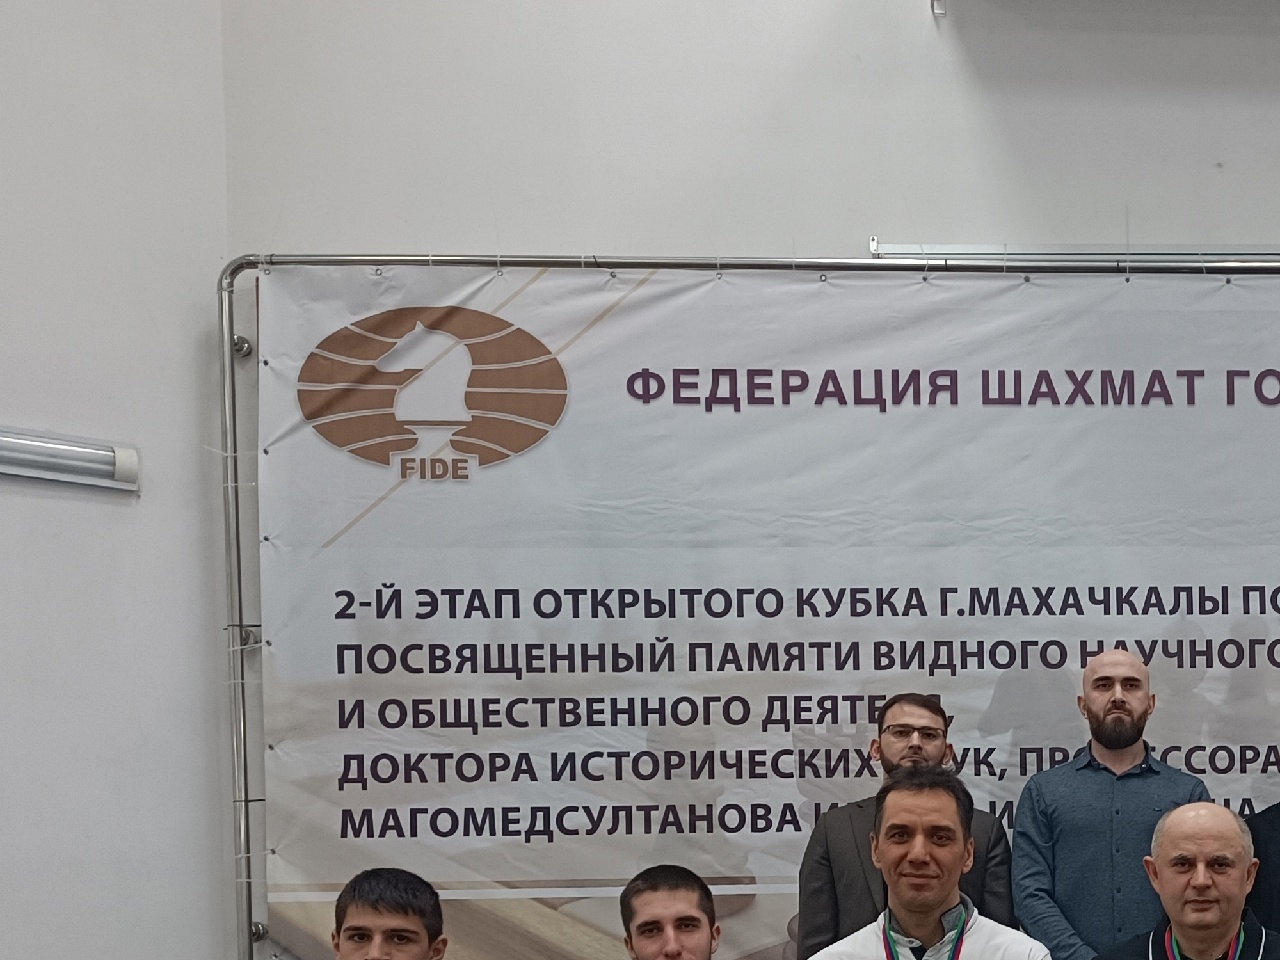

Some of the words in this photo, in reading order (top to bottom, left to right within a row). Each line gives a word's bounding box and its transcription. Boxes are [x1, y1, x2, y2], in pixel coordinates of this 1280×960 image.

[627, 368, 958, 412] ФЕДЕРАЦИЯ
[982, 370, 1205, 405] ШАХМАТ
[401, 458, 468, 479] FIDE
[335, 583, 402, 620] 2-Й
[415, 588, 520, 619] ЭТАП
[534, 588, 784, 619] ОТКРЫТОГО
[797, 587, 928, 617] КУБКА
[940, 585, 1229, 617] Г.МАХАЧКАЛЫ
[337, 637, 675, 680] ПОСВЯЩЕННЫЙ
[689, 641, 861, 672] ПАМЯТИ
[874, 640, 1067, 677] ВИДНОГО
[339, 699, 365, 729] И
[378, 696, 751, 735] ОБЩЕСТВЕННОГО
[338, 753, 538, 791] ДОКТОРА
[551, 748, 879, 782] ИСТОРИЧЕСКИХ
[340, 803, 802, 843] МАГОМЕДСУЛТАНОВА
